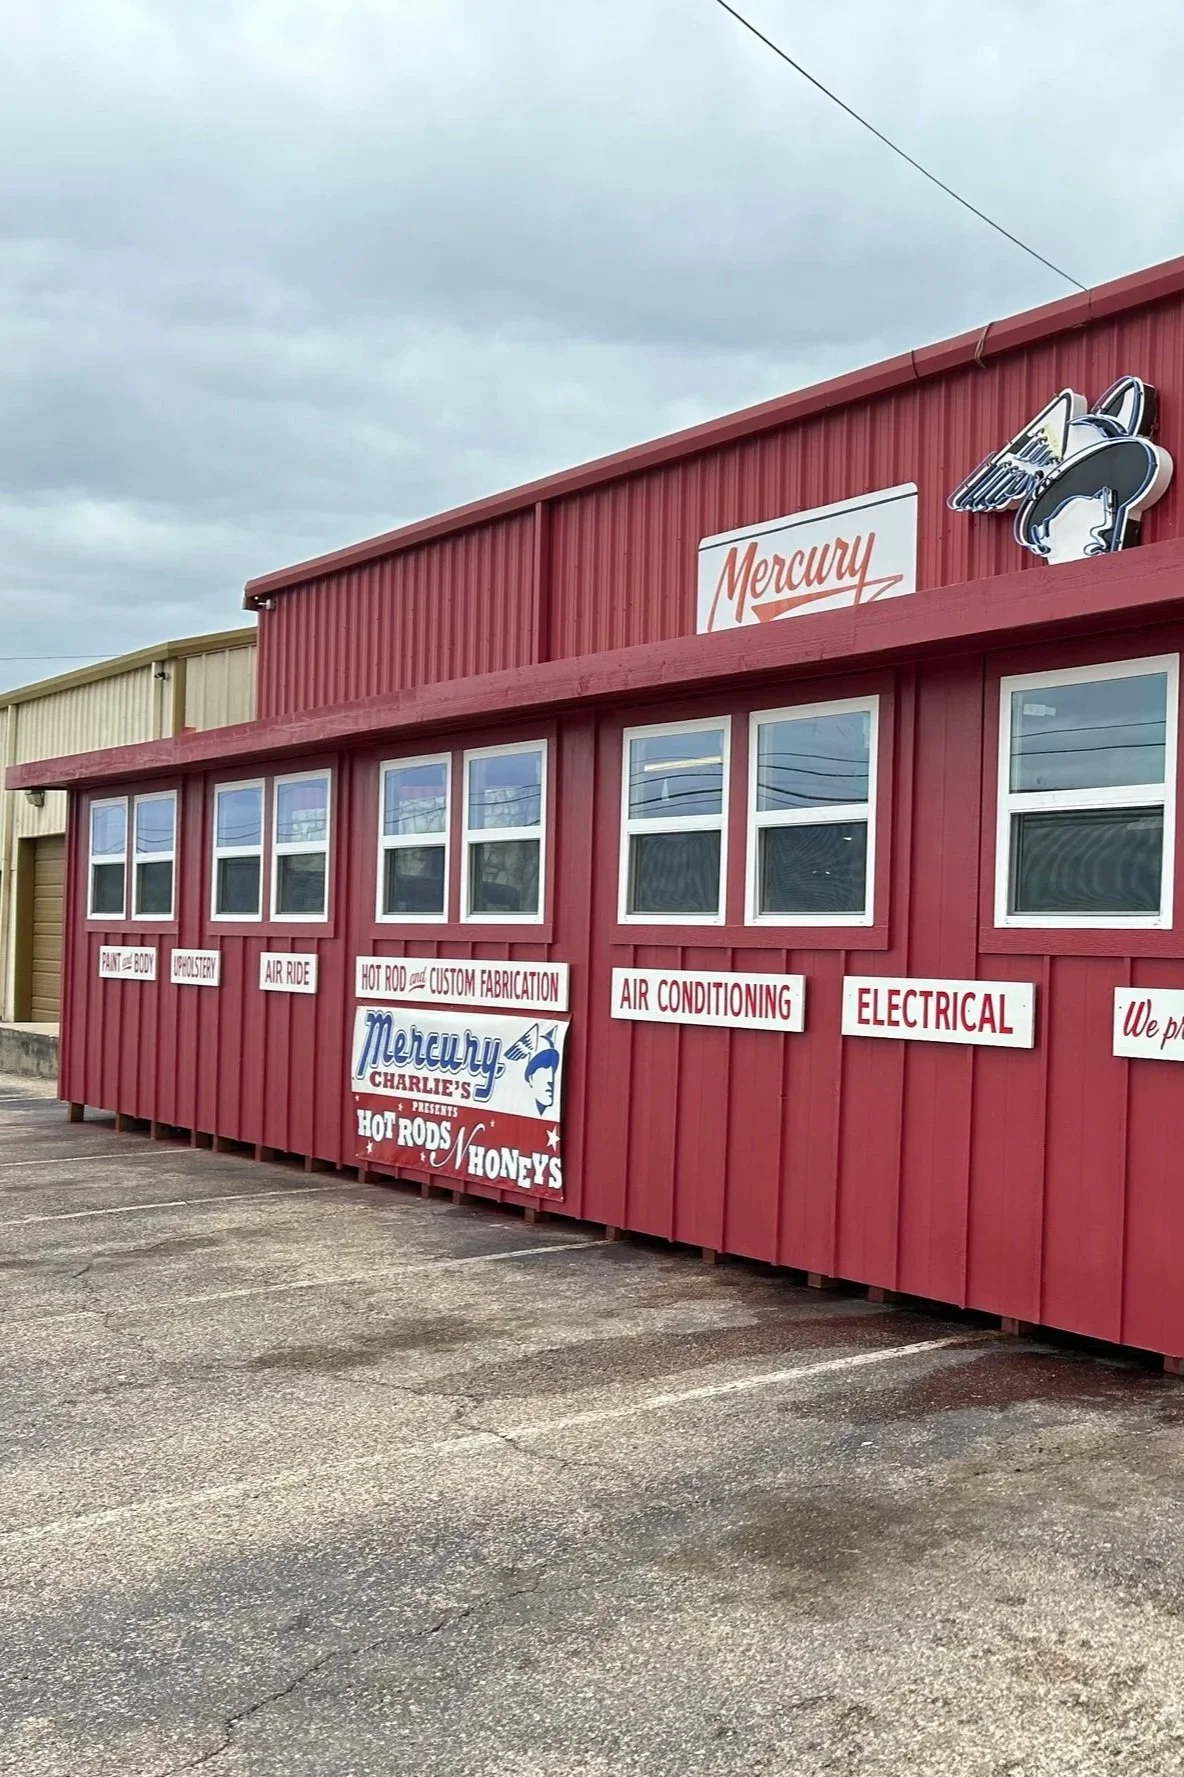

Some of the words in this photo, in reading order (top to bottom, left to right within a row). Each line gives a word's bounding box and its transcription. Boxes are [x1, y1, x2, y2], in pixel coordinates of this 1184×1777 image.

[707, 532, 904, 633] Mercury
[101, 952, 121, 972] PAINT
[134, 953, 154, 973] BODY
[173, 955, 217, 979] UPHOLSTERY
[265, 960, 283, 984] AIR
[286, 961, 310, 986] RIDE
[361, 964, 382, 991] HOT
[384, 965, 407, 992] ROD
[408, 967, 427, 992] and
[429, 967, 476, 997] CUSTOM
[480, 969, 559, 1002] FABRICATION
[619, 978, 649, 1011] AIR
[657, 979, 792, 1020] CONDITIONING
[856, 987, 1014, 1035] ELECTRICAL
[1123, 999, 1160, 1038] We
[355, 1010, 506, 1104] Mercury
[369, 1070, 472, 1100] CHARLIE'S
[411, 1101, 459, 1118] PRESENTS
[356, 1109, 396, 1142] HOT
[397, 1116, 452, 1151] RODS
[428, 1122, 486, 1170] N
[467, 1144, 563, 1189] HONEYS
